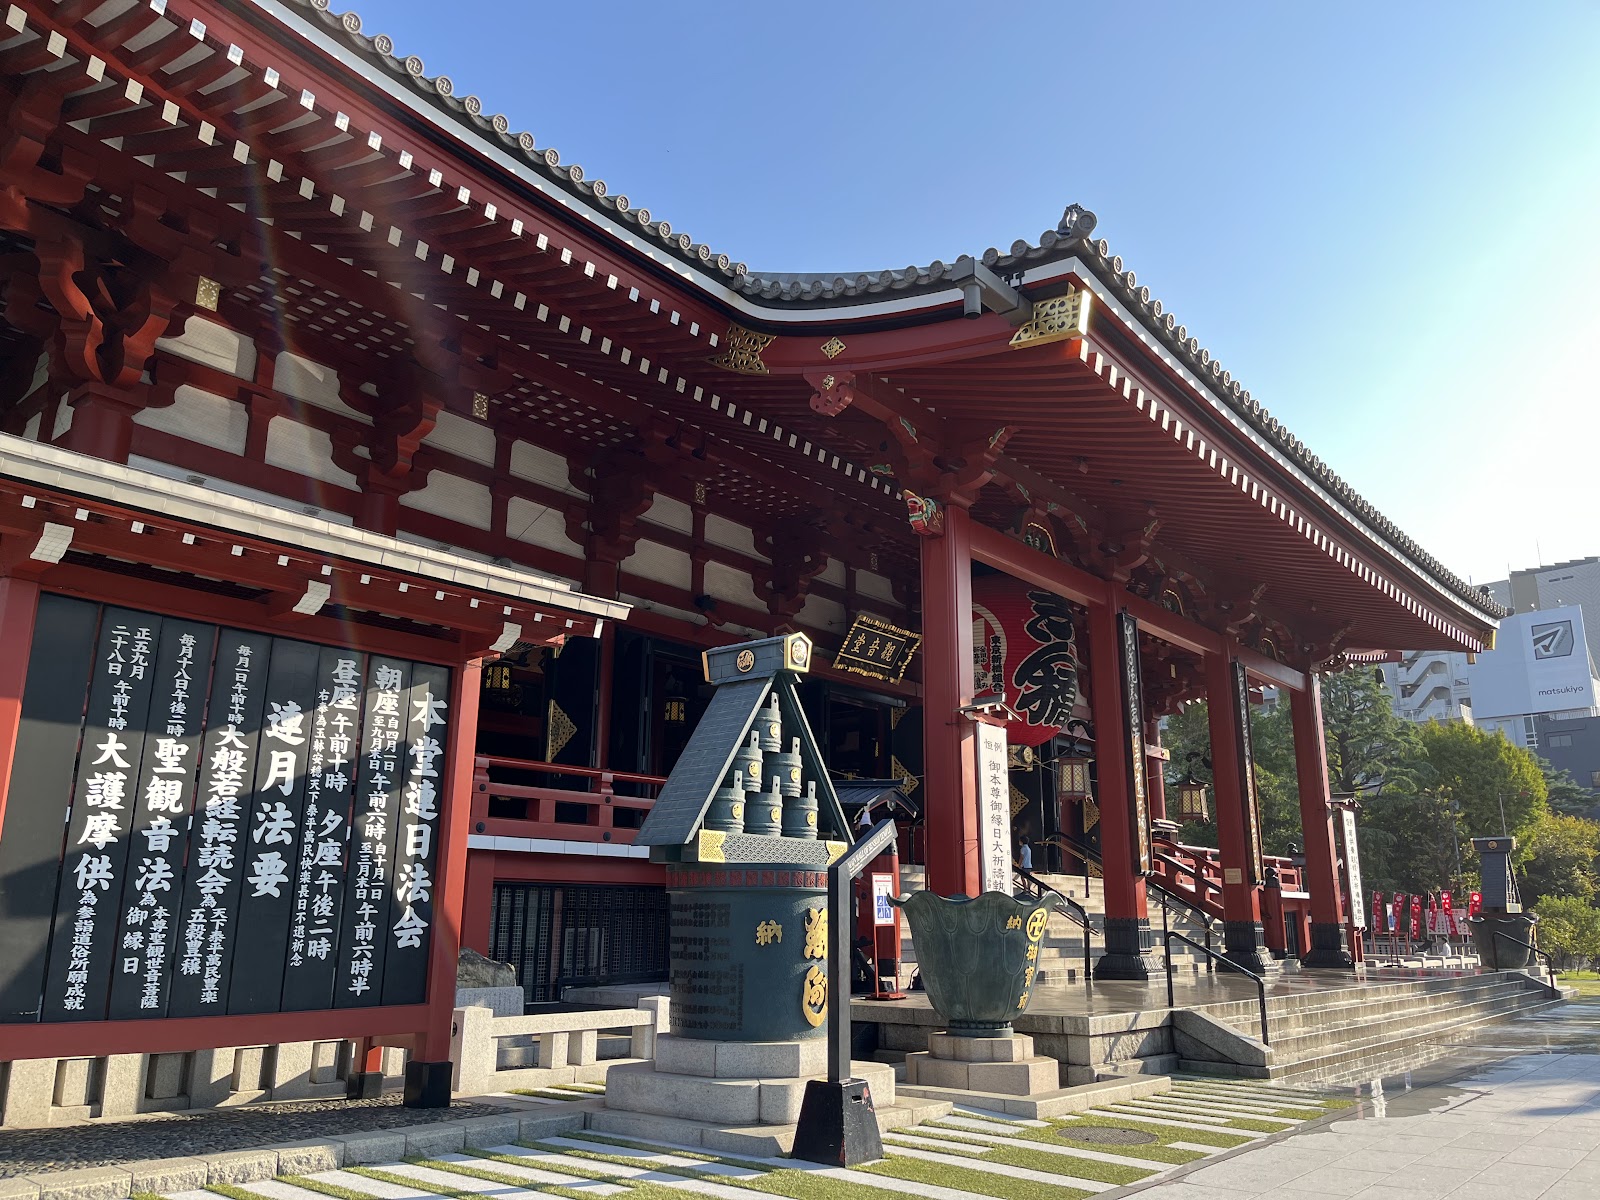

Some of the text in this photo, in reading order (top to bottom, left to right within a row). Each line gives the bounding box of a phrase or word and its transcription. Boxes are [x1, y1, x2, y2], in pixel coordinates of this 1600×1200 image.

[107, 625, 130, 676] 二十八日
[129, 627, 152, 680] 正五九月
[108, 680, 133, 731] 午前十時
[328, 658, 361, 711] 昼座
[372, 664, 402, 717] 朝座
[1538, 685, 1584, 696] matsukiyo
[325, 713, 353, 793] 午前十時
[383, 716, 400, 773] 自四月一日
[984, 738, 1003, 753] 恒例
[72, 732, 132, 891] 大護摩供
[135, 737, 190, 892] 聖観音法
[196, 724, 250, 895] 大般若経転読会
[248, 699, 306, 898] 連月法要
[365, 772, 391, 841] 午前六時
[392, 691, 449, 949] 本堂連日法会
[355, 842, 373, 900] 至三月末日
[371, 841, 388, 901] 自十月一日
[307, 869, 338, 960] 午後二時
[755, 919, 782, 946] 納
[1006, 914, 1022, 930] 納
[348, 901, 379, 997] 午前六時半
